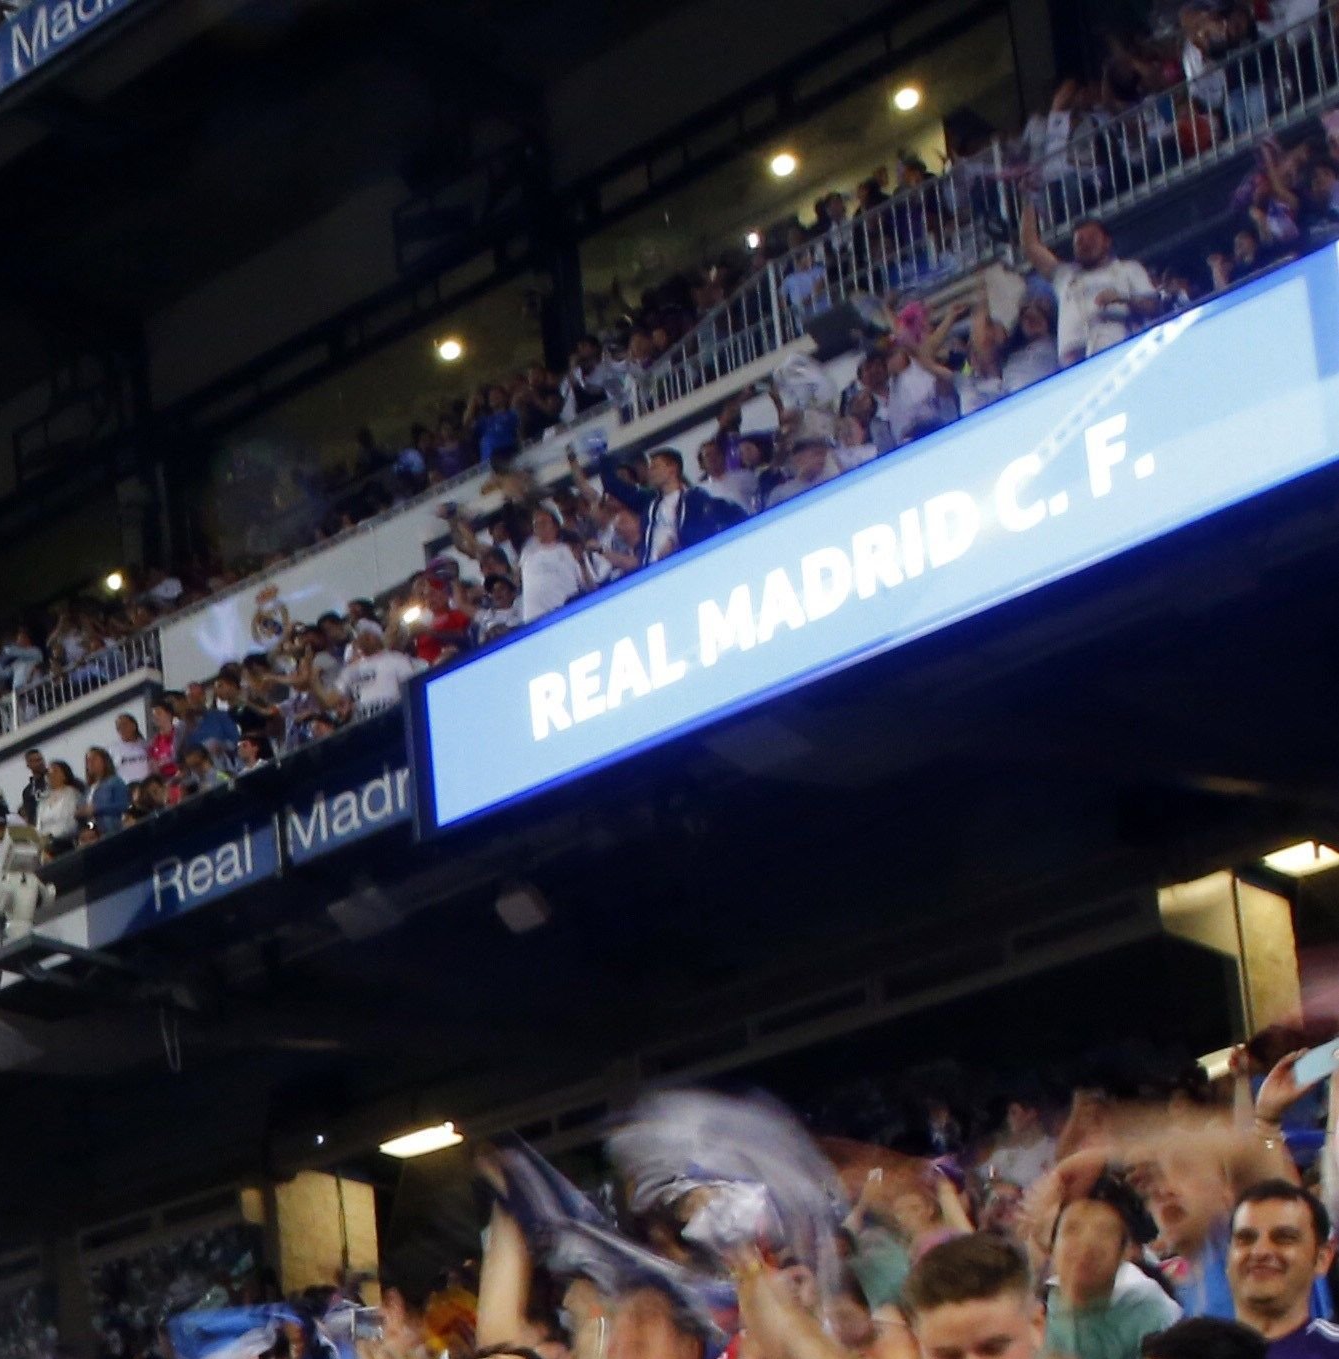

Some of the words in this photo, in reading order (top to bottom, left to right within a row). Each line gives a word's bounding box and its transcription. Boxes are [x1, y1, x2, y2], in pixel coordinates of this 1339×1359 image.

[12, 0, 115, 77] Mad
[528, 622, 686, 741] REAL
[696, 489, 981, 668] MADRID
[994, 453, 1070, 534] C.
[1083, 412, 1156, 499] F.
[151, 822, 254, 913] Real
[285, 764, 410, 857] Madr
